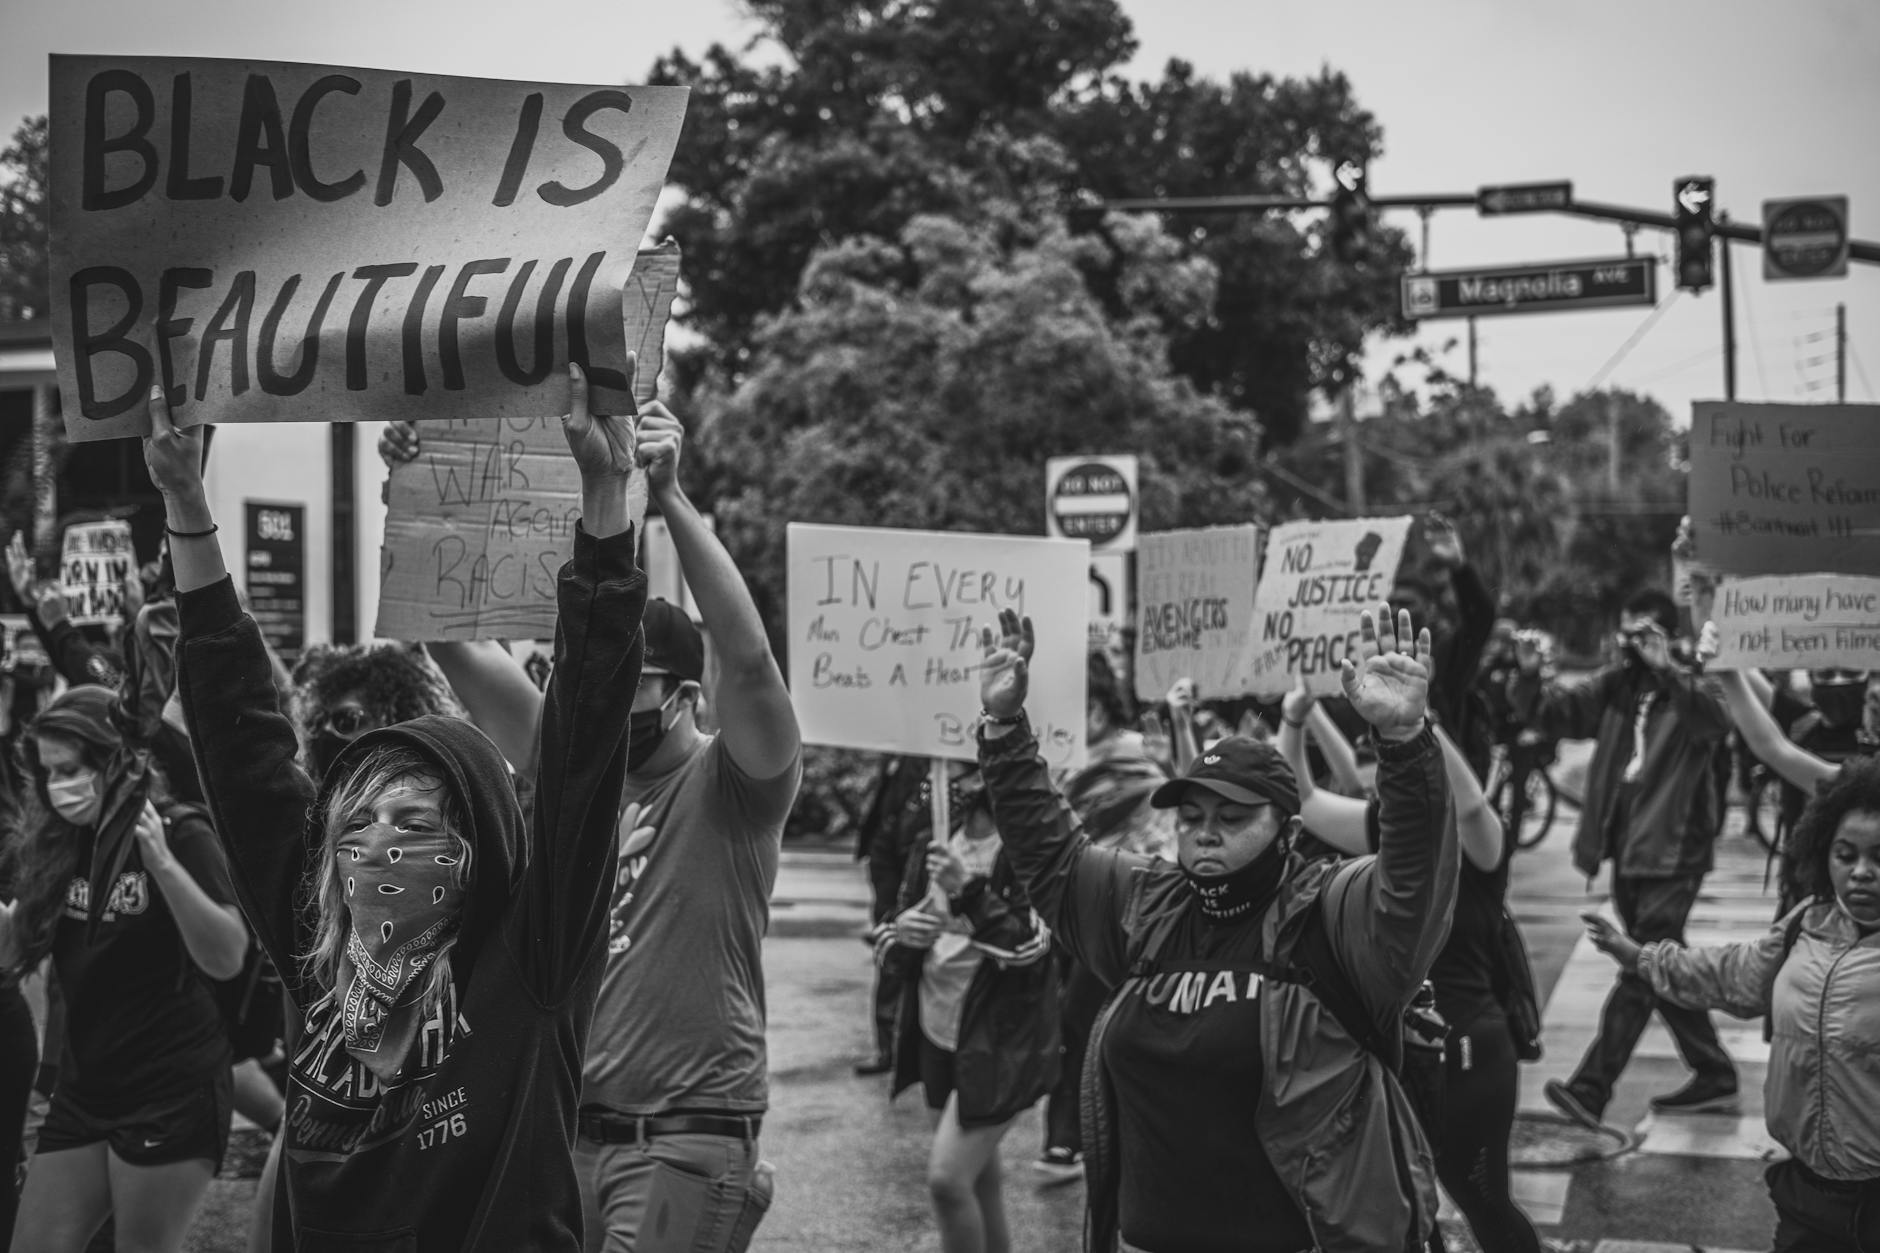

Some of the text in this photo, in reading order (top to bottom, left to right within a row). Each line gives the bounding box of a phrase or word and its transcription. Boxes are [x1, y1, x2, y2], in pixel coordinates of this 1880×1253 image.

[82, 69, 633, 211] BLACK IS
[1459, 269, 1582, 309] Magnolia
[69, 251, 629, 420] BEAUTIFUL
[1711, 412, 1763, 460] Fight
[430, 440, 529, 506] WAR
[1730, 464, 1802, 502] Police
[1280, 543, 1313, 573] NO
[812, 555, 880, 609] IN
[1288, 574, 1383, 608] JUSTICE
[1143, 597, 1229, 633] AVENGERS
[1724, 587, 1877, 622] How many have
[1263, 611, 1294, 641] NO
[1740, 625, 1770, 652] not
[1781, 628, 1829, 652] been
[1287, 631, 1360, 674] PEACE
[888, 662, 908, 687] A
[925, 657, 982, 686] Hear
[423, 1087, 467, 1119] SINCE
[417, 1113, 468, 1151] 1776
